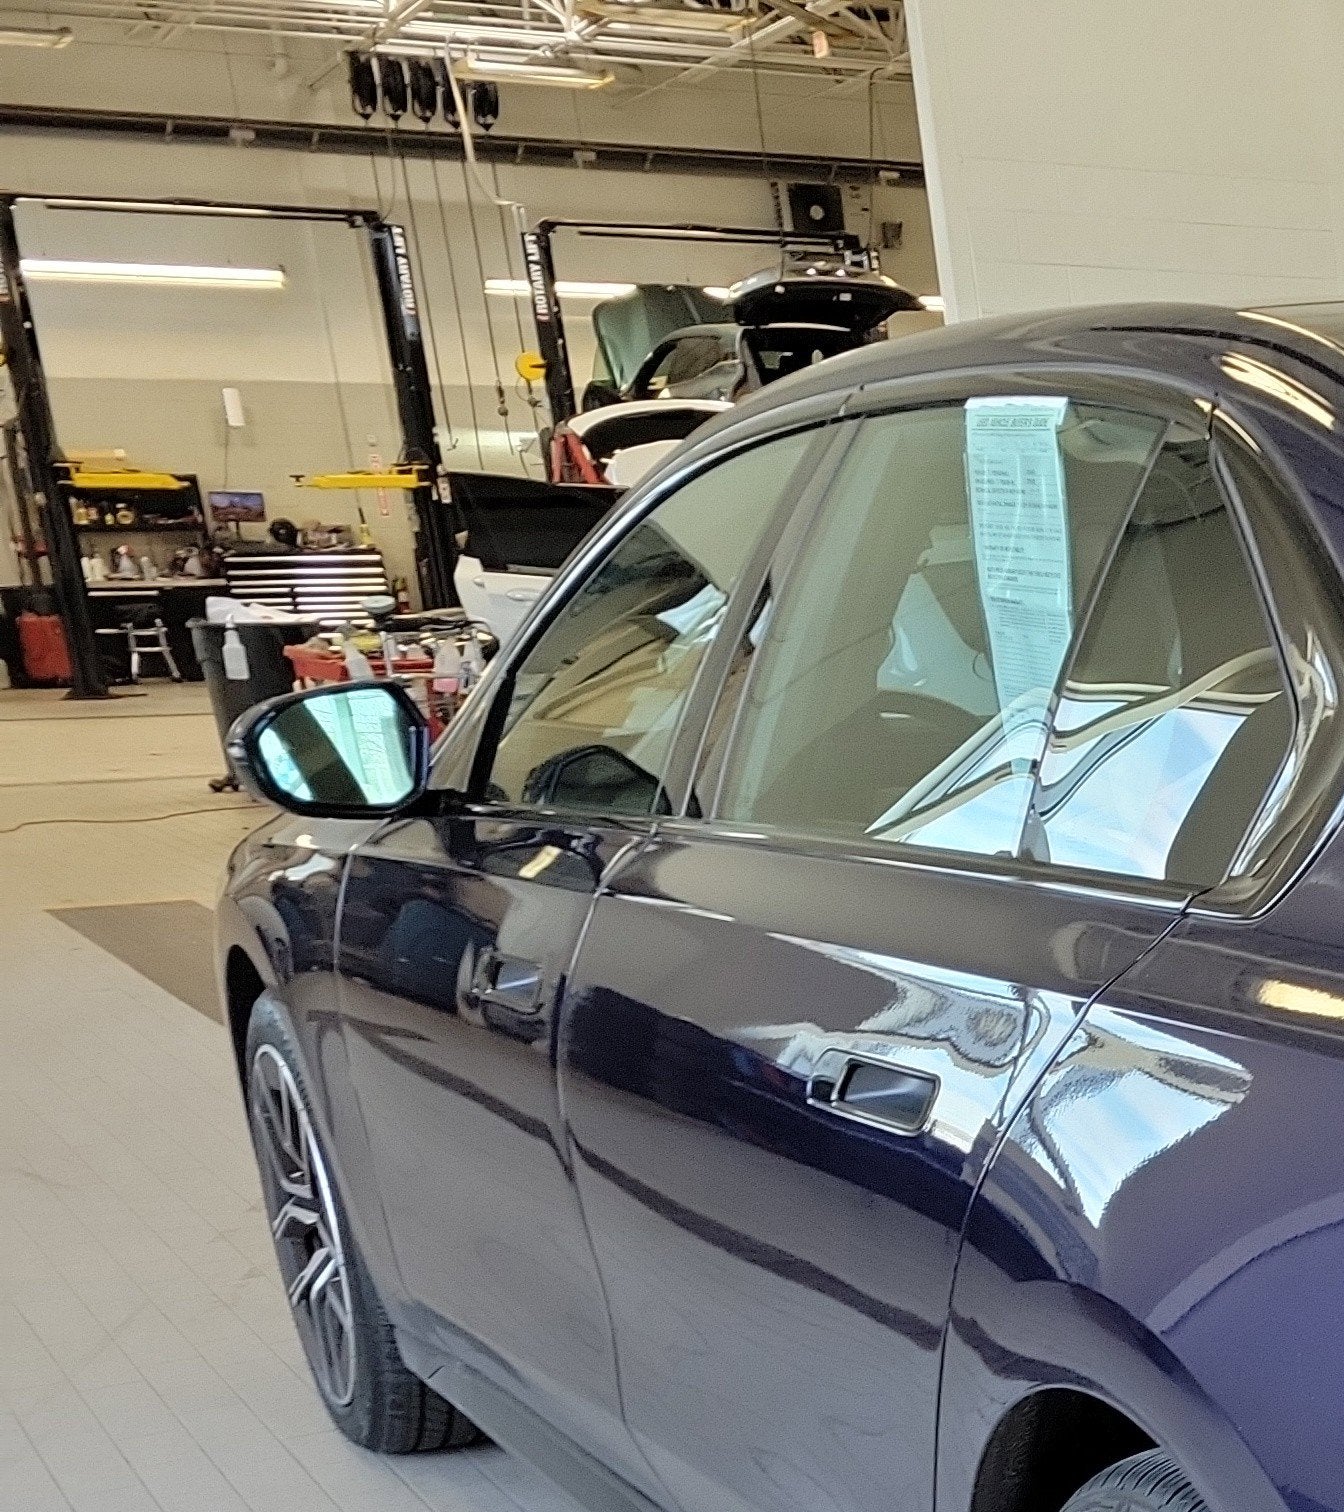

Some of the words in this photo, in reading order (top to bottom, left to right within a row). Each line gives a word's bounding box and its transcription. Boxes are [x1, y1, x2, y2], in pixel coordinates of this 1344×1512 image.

[391, 226, 406, 254] LIFT
[523, 233, 540, 261] LIFT
[396, 256, 416, 308] ROTARY
[528, 263, 549, 314] ROTARY
